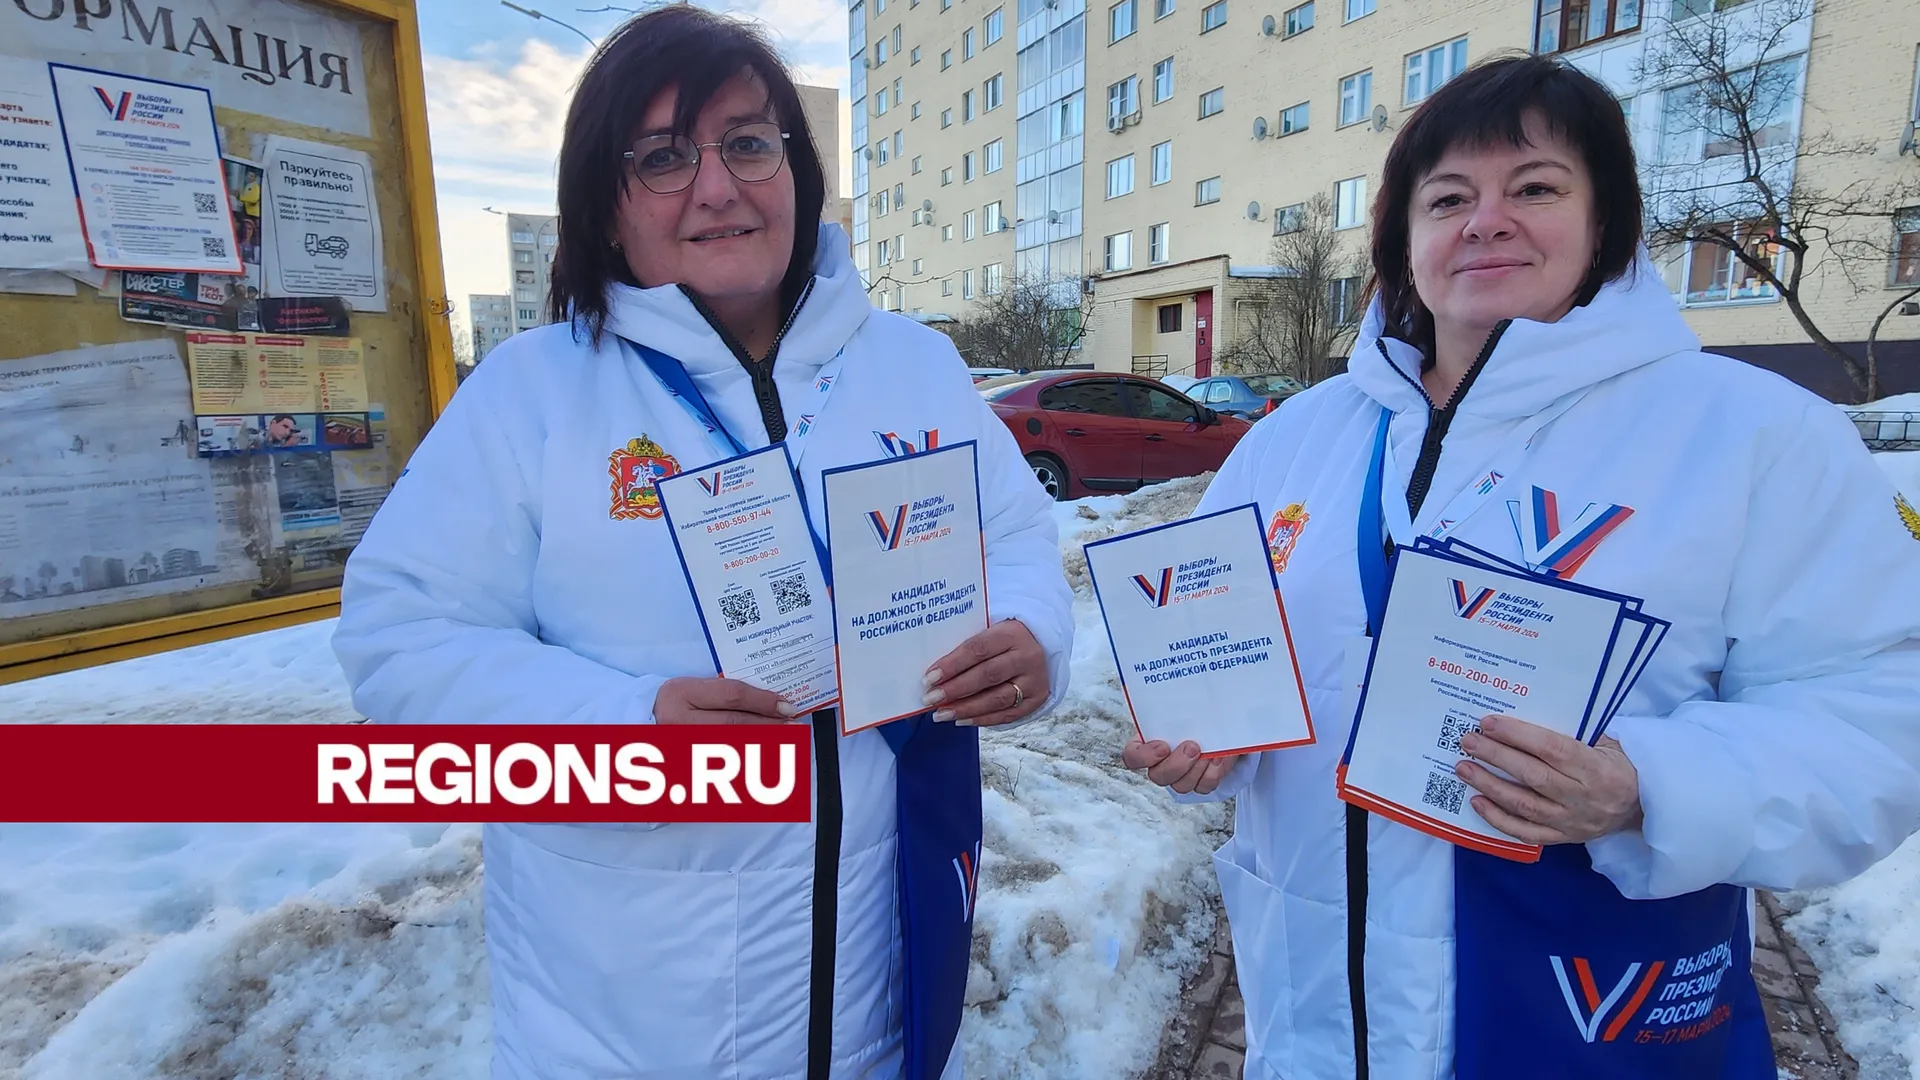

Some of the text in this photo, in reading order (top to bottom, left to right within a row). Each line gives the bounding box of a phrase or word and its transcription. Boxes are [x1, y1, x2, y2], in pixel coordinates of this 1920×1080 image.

[136, 93, 172, 105] ВЫБОРЫ
[131, 110, 164, 121] РОССИИ
[134, 101, 184, 115] ПРЕЗИДЕНТА
[280, 160, 354, 182] Паркуйтесь
[5, 175, 51, 186] участка;
[283, 175, 354, 193] правильно!
[31, 234, 54, 243] УИК
[126, 273, 185, 290] МИСТЕР
[723, 468, 754, 481] ПРЕЗИДЕНТА
[724, 464, 746, 475] ВЫБОРЫ
[703, 506, 724, 516] Телефон
[912, 494, 945, 511] ВЫБОРЫ
[706, 507, 772, 534] 8-800-550-97-44
[909, 503, 954, 523] ПРЕЗИДЕНТА
[906, 520, 937, 536] РОССИИ
[920, 530, 939, 542] МАРТА
[939, 526, 951, 537] 2024
[724, 547, 780, 571] 8-800-200-00-20
[1178, 556, 1217, 573] ВЫБОРЫ
[1176, 563, 1232, 584] ПРЕЗИДЕНТА
[891, 578, 947, 602] КАНДИДАТЫ
[1174, 579, 1210, 594] РОССИИ
[1191, 589, 1213, 600] МАРТА
[1213, 584, 1229, 595] 2024
[851, 582, 977, 628] НА ДОЛЖНОСТЬ ПРЕЗИДЕНТА
[1498, 592, 1544, 610] ВЫБОРЫ
[859, 599, 974, 641] РОССИЙСКОЙ ФЕДЕРАЦИИ
[1483, 609, 1525, 625] РОССИИ
[1490, 600, 1555, 623] ПРЕЗИДЕНТА
[1498, 622, 1522, 634] МАРТА
[1521, 628, 1540, 639] 2024
[1168, 631, 1229, 652] КАНДИДАТЫ
[1134, 636, 1273, 673] НА ДОЛЖНОСТЬ ПРЕЗИДЕНТА
[1433, 634, 1537, 671] Информационно-справочный центр
[1464, 652, 1500, 667] ЦИК России
[1144, 651, 1270, 685] РОССИЙСКОЙ ФЕДЕРАЦИИ
[1427, 656, 1529, 698] 8-800-200-00-20
[1430, 677, 1460, 692] Бесплатно
[1468, 689, 1482, 699] всей
[1482, 695, 1517, 710] территории
[1437, 687, 1505, 714] Российской Федерации
